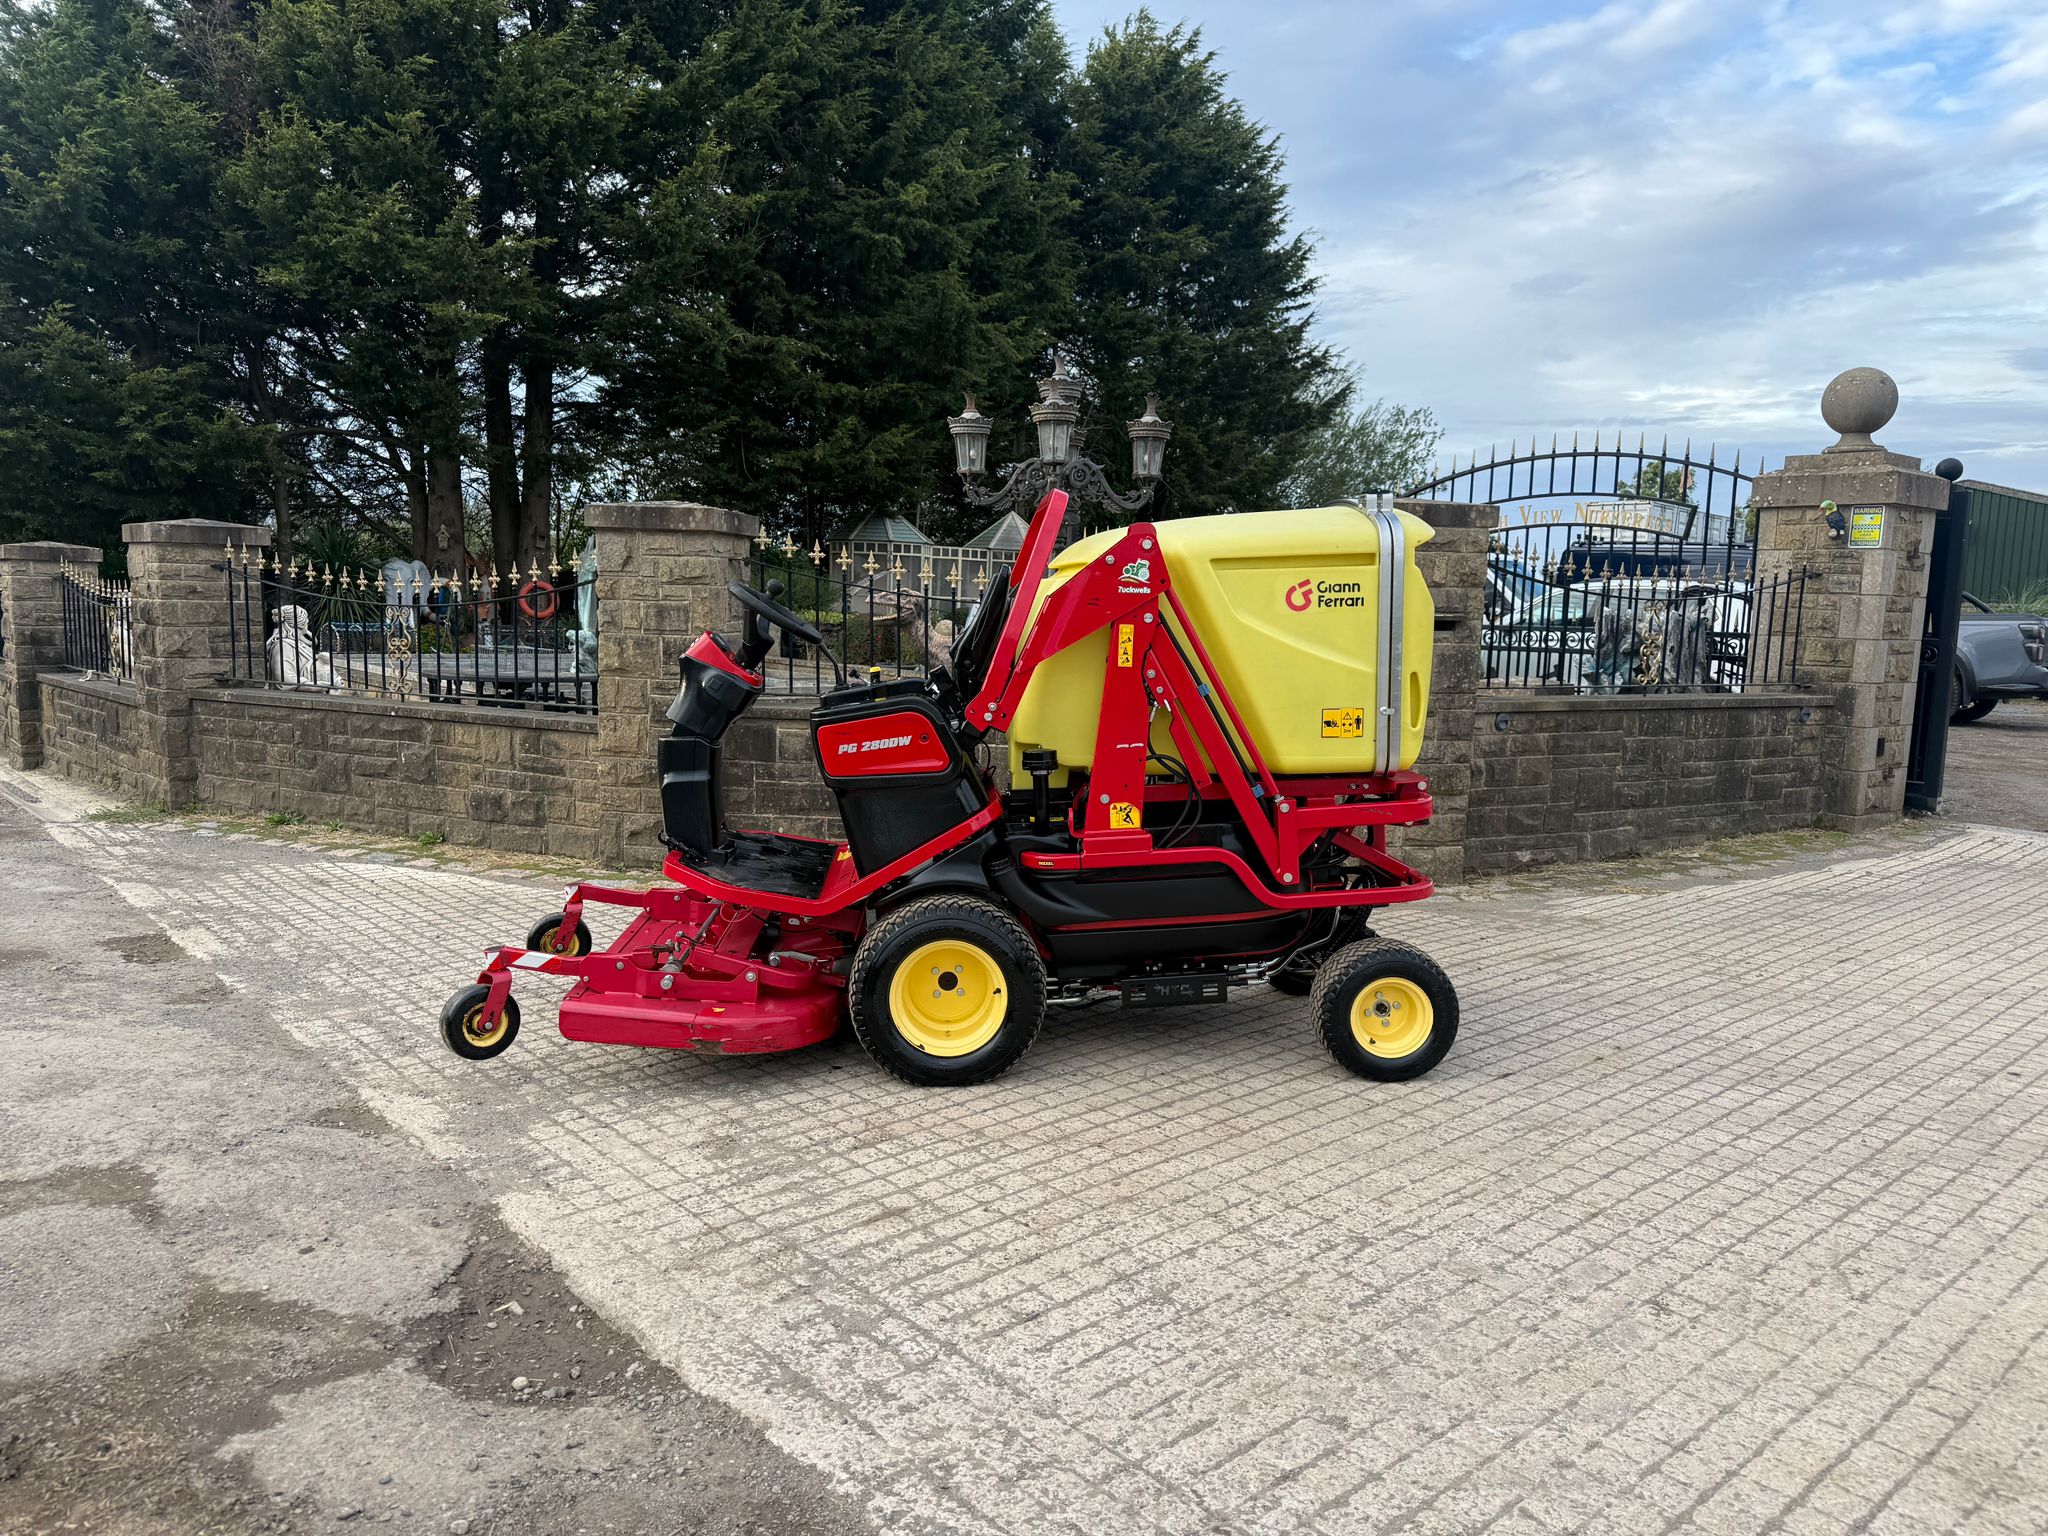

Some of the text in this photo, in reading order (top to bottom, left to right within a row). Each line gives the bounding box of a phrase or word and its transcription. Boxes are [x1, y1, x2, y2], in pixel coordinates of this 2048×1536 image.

[1519, 504, 1563, 525] VIEW
[1117, 585, 1152, 594] Tuckwells
[1318, 594, 1364, 608] Ferrari
[838, 743, 858, 755] PG
